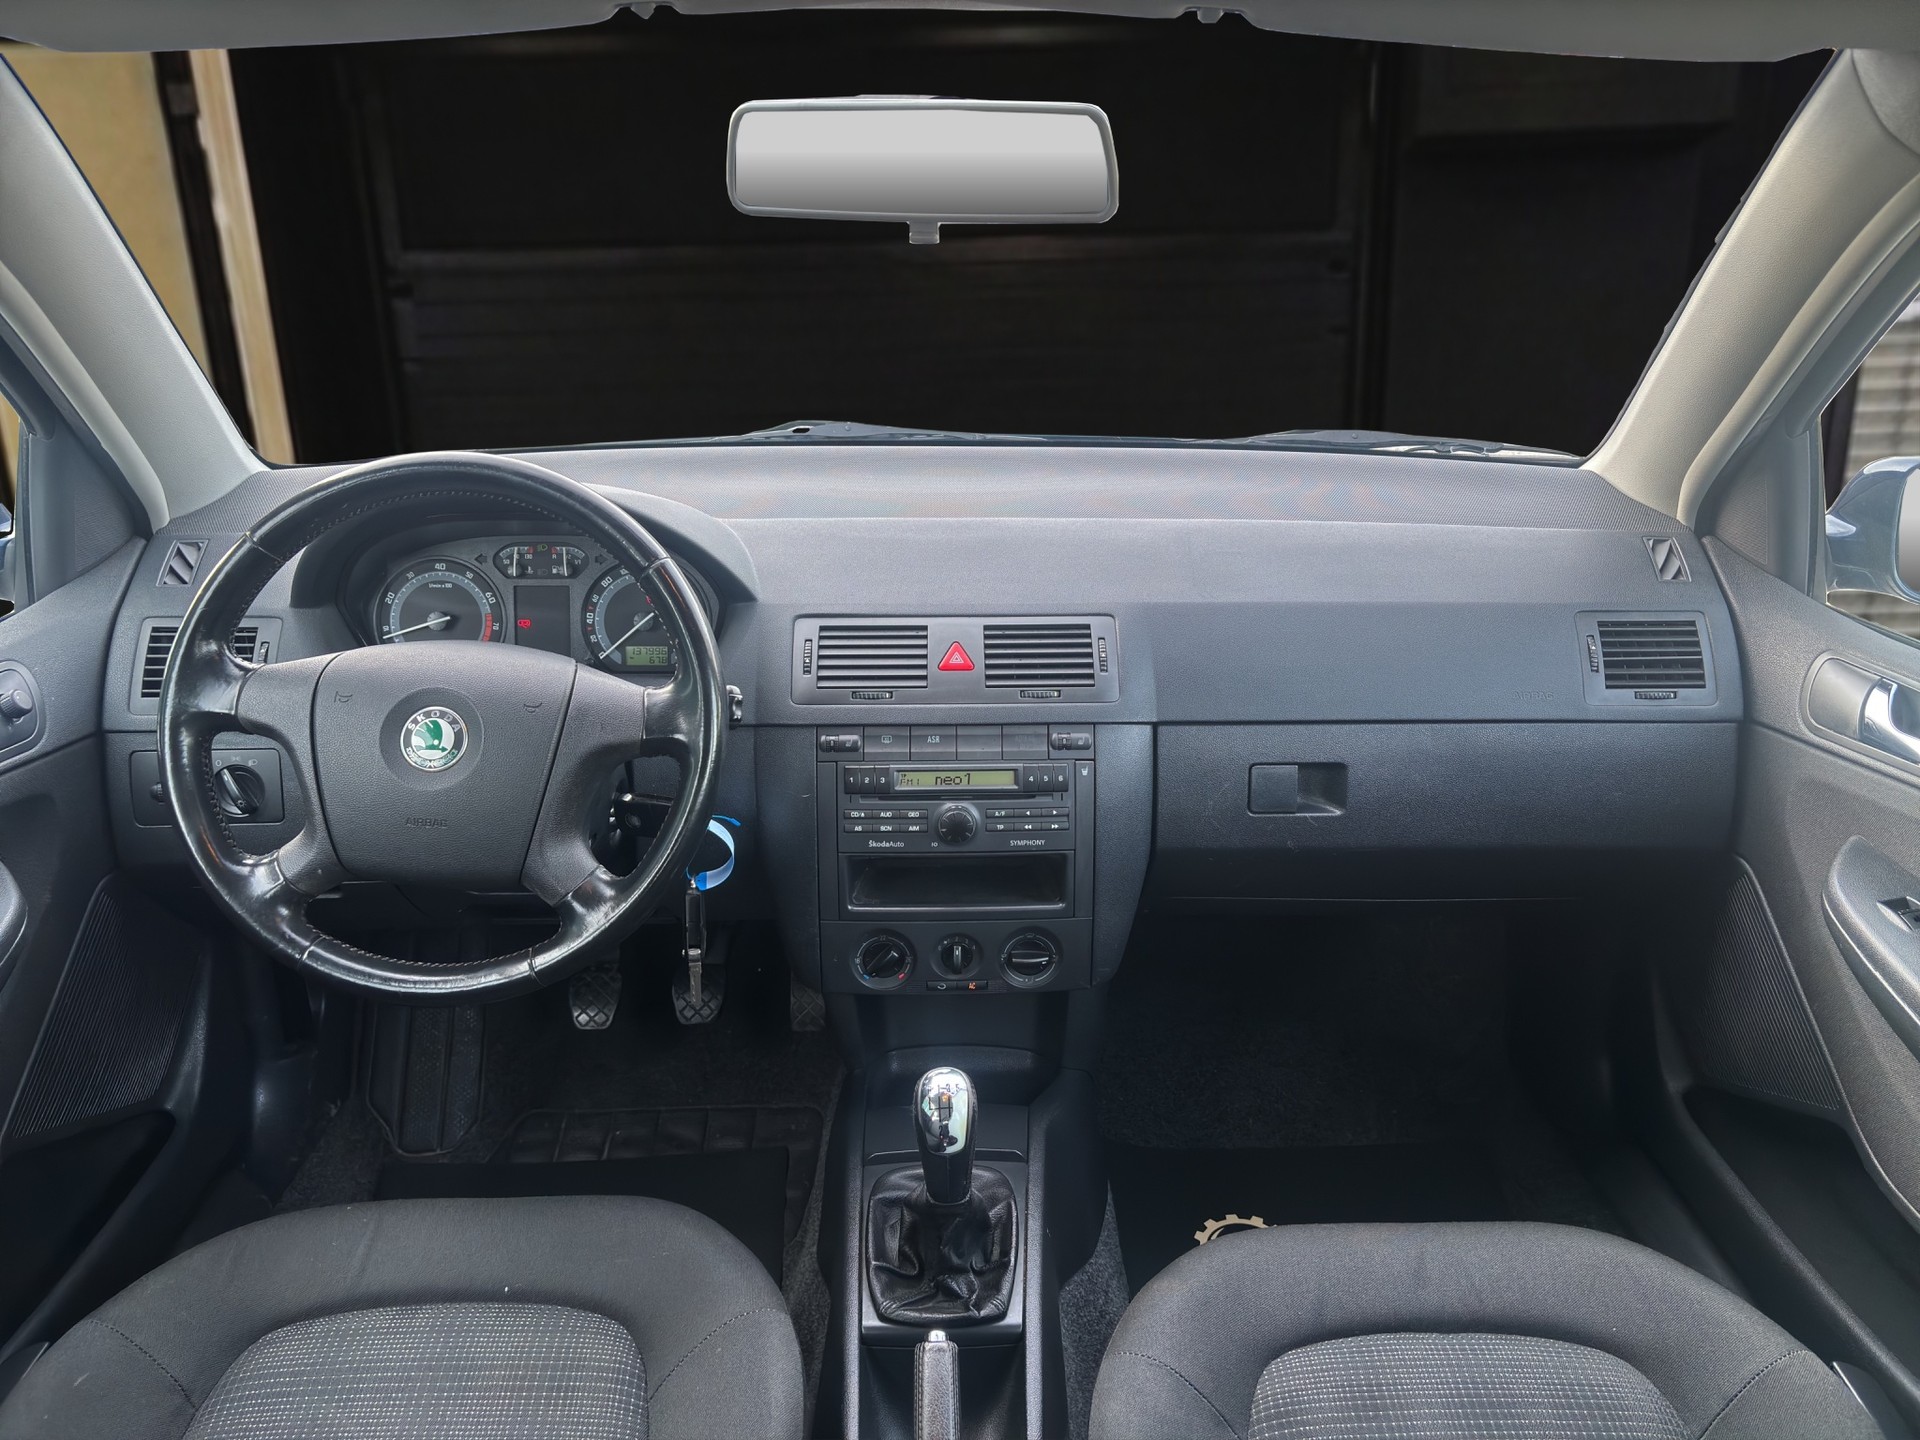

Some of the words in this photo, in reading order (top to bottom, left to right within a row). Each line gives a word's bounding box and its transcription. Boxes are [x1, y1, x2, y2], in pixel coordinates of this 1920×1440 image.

[406, 571, 415, 580] 30
[465, 571, 474, 579] 50
[600, 576, 613, 588] 80
[385, 591, 395, 604] 20
[485, 591, 496, 604] 60
[592, 594, 600, 603] 60
[586, 612, 594, 622] 40
[492, 622, 499, 631] 70
[404, 817, 447, 828] AIRBAG
